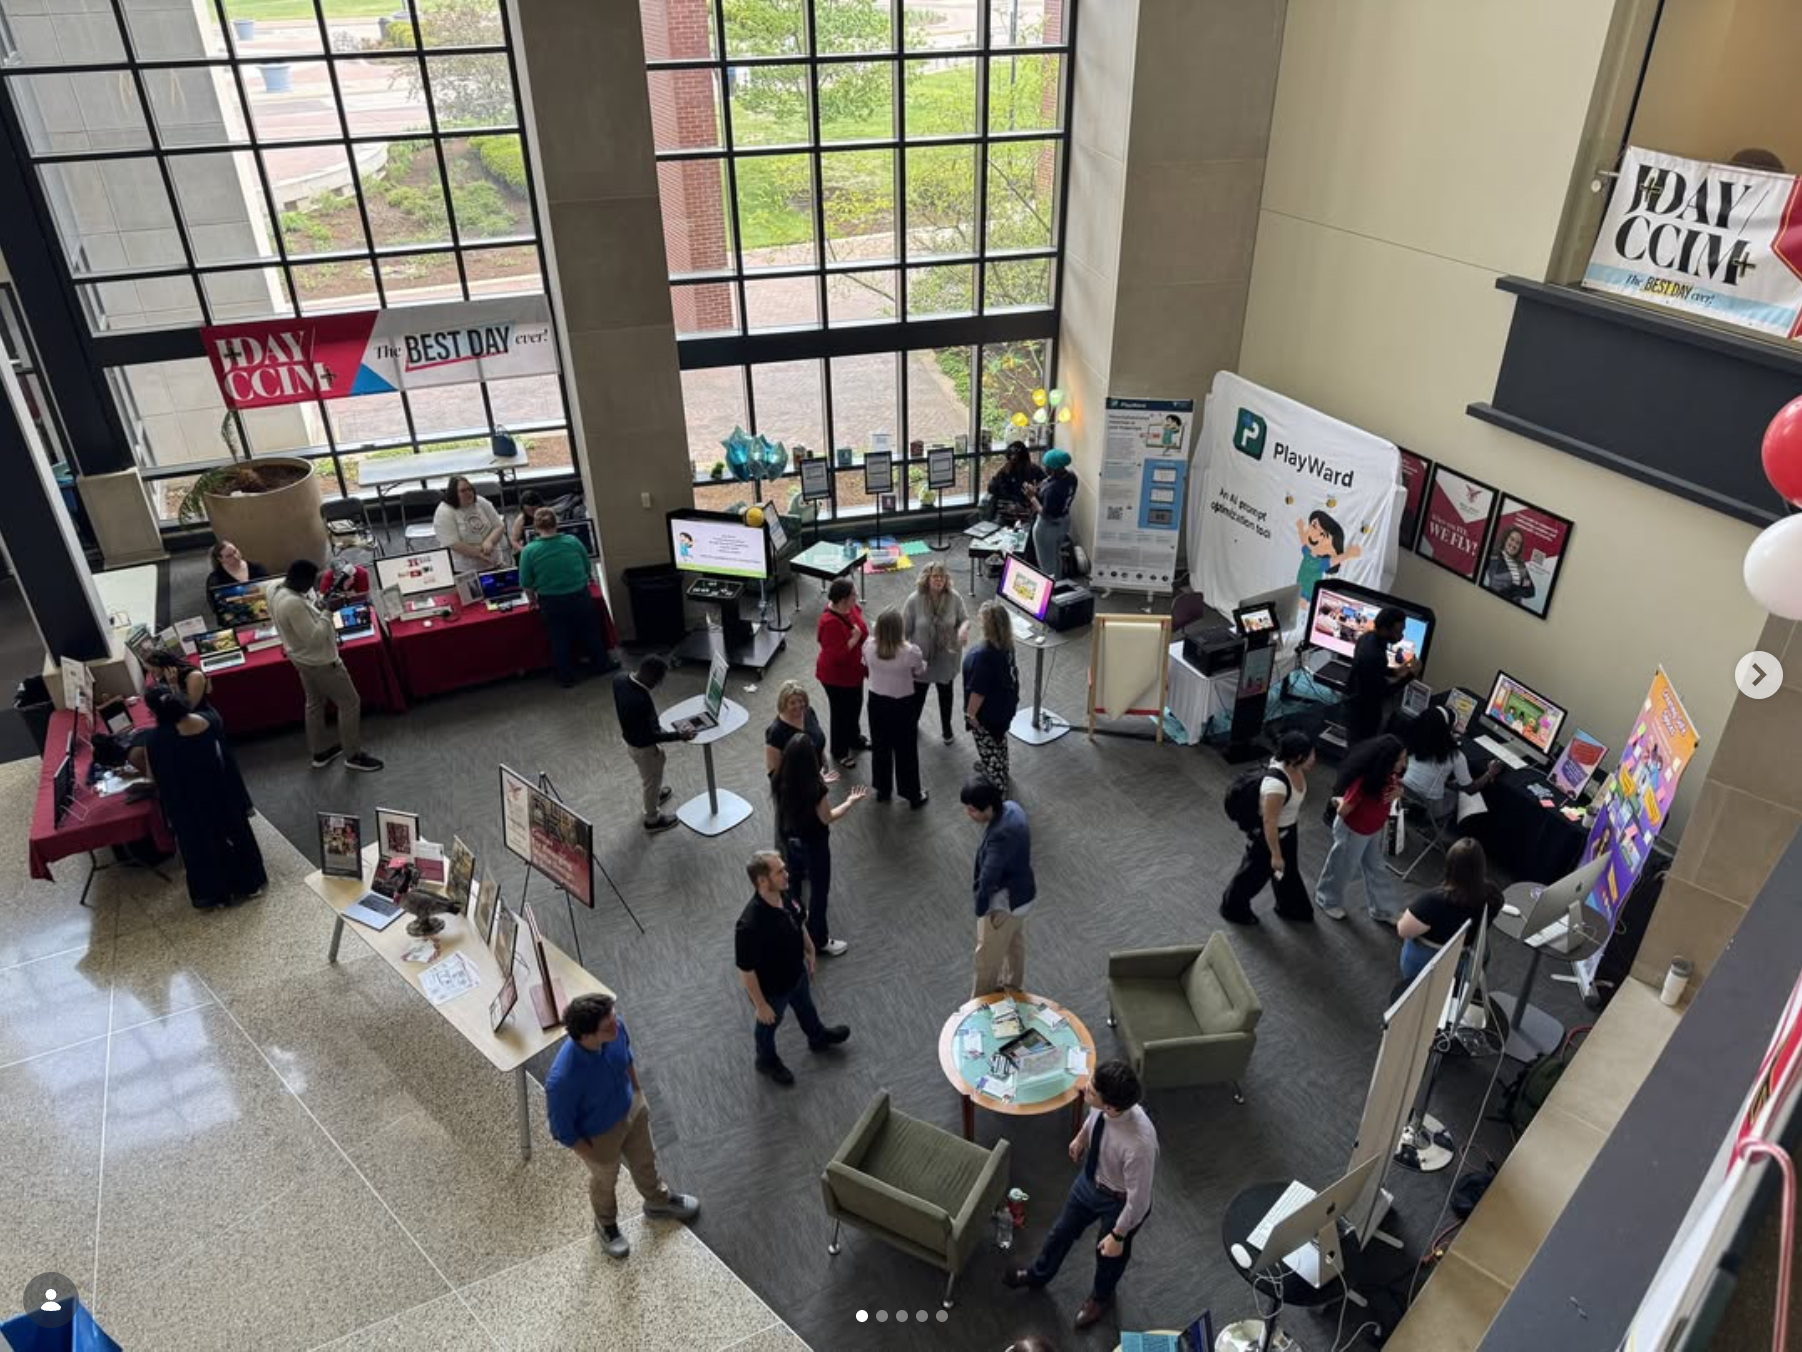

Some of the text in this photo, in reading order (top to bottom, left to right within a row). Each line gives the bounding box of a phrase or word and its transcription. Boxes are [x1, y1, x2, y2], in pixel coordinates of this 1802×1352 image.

[1644, 276, 1671, 295] BEST
[1670, 282, 1694, 300] DAY
[374, 326, 548, 363] The BEST DAY ever!
[1273, 442, 1355, 488] PlayWard
[1211, 501, 1271, 539] optimization tool
[1219, 487, 1267, 521] An AI prompt
[1430, 521, 1450, 543] WE
[1450, 533, 1478, 557] FLY!
